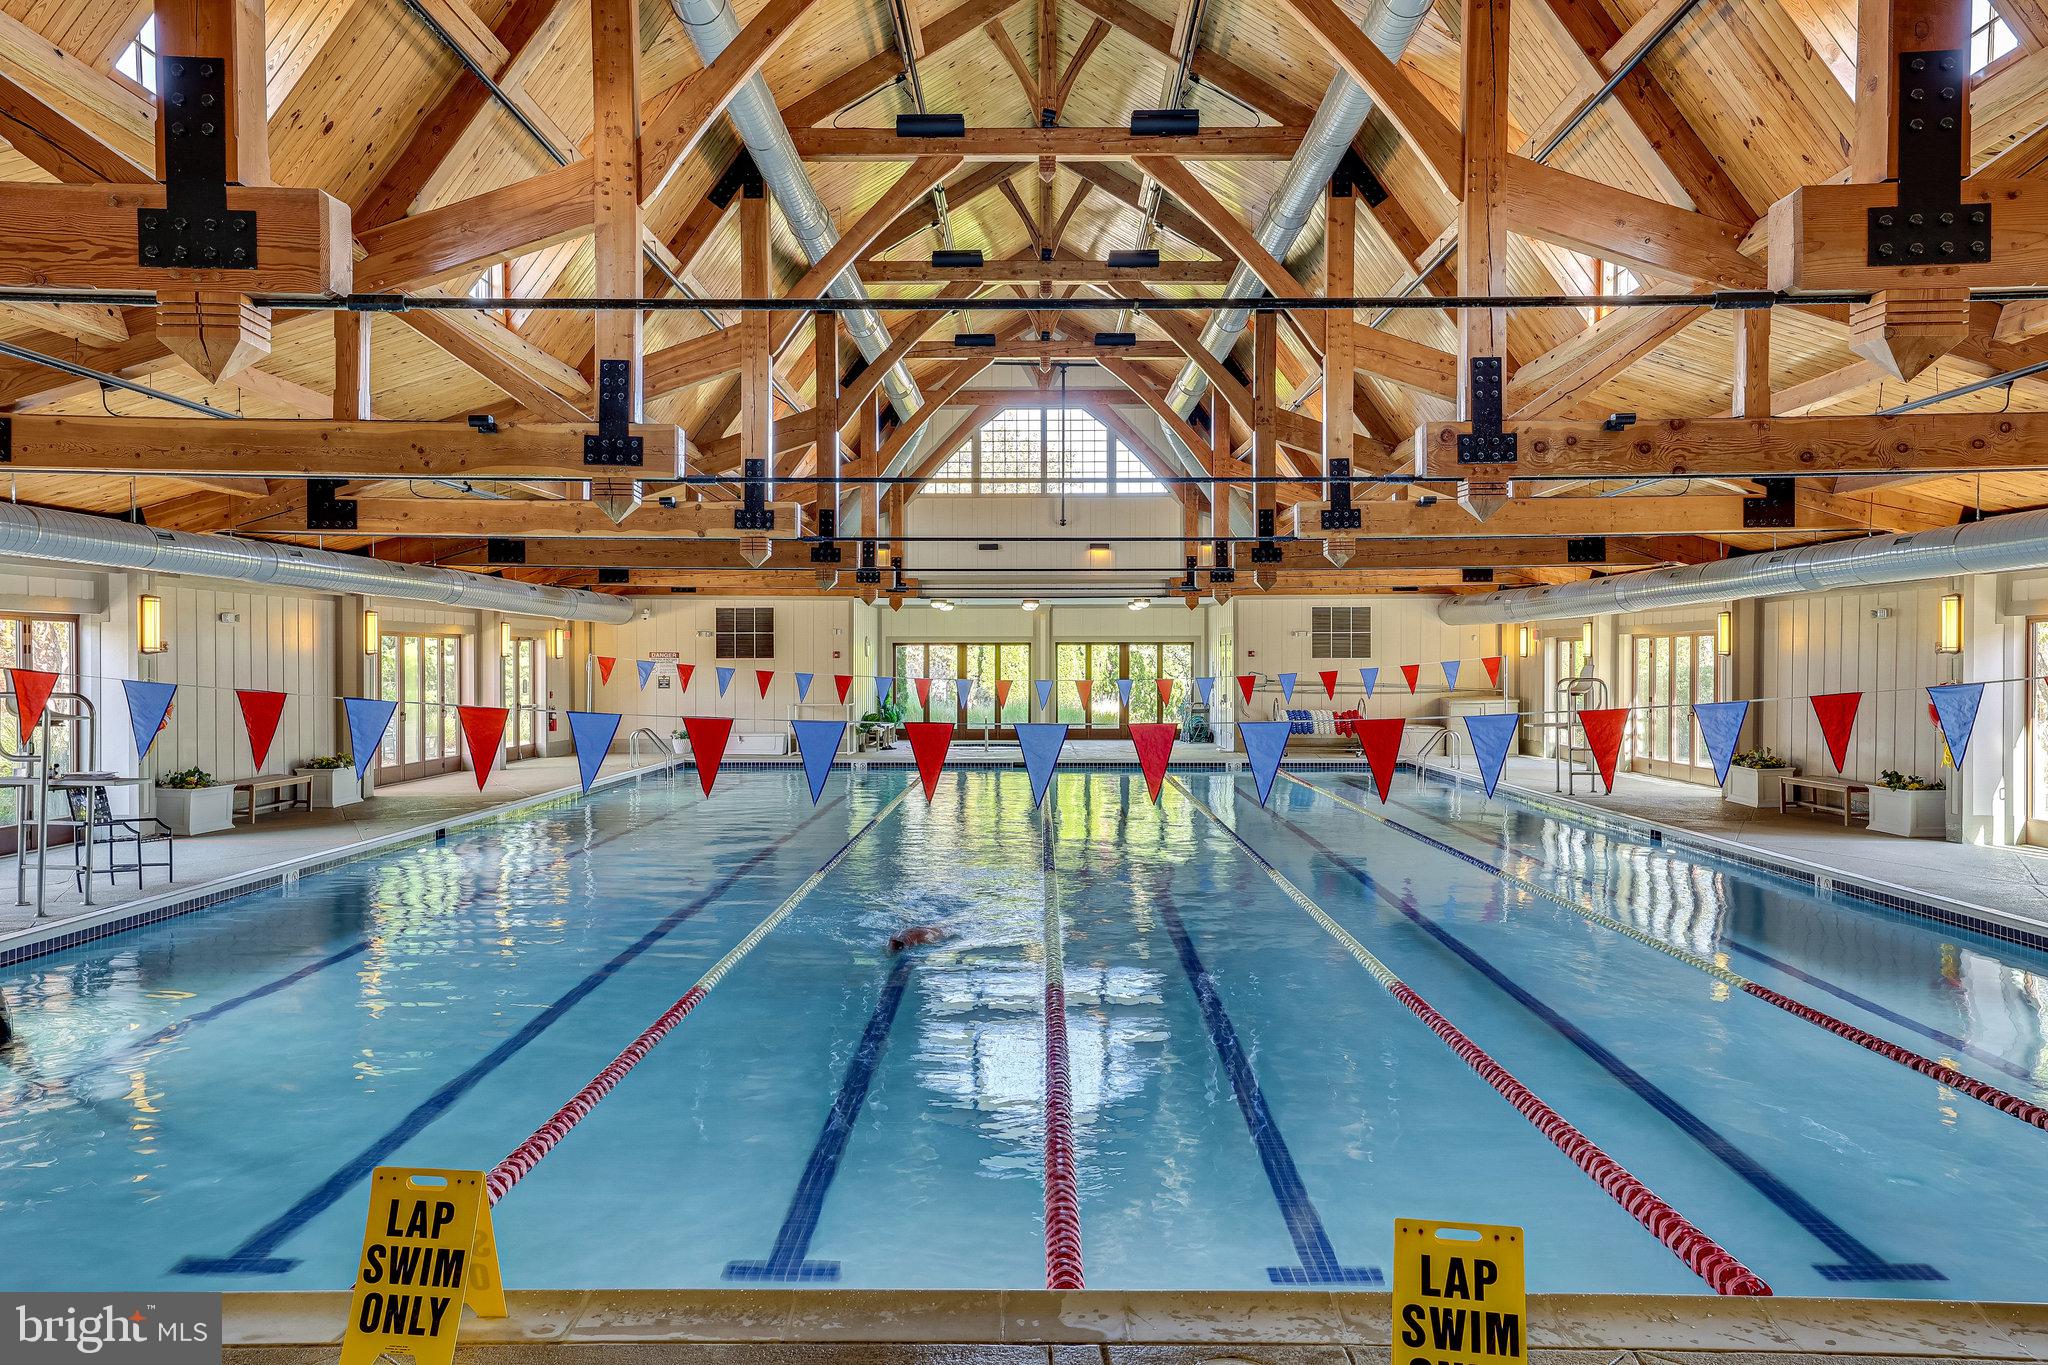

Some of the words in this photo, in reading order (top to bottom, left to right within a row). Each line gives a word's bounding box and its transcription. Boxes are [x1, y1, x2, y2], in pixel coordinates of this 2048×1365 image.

[386, 1199, 455, 1239] LAP
[363, 1244, 465, 1288] SWIM
[1421, 1254, 1498, 1301] LAP
[359, 1293, 451, 1336] ONLY
[1402, 1304, 1520, 1357] SWIM
